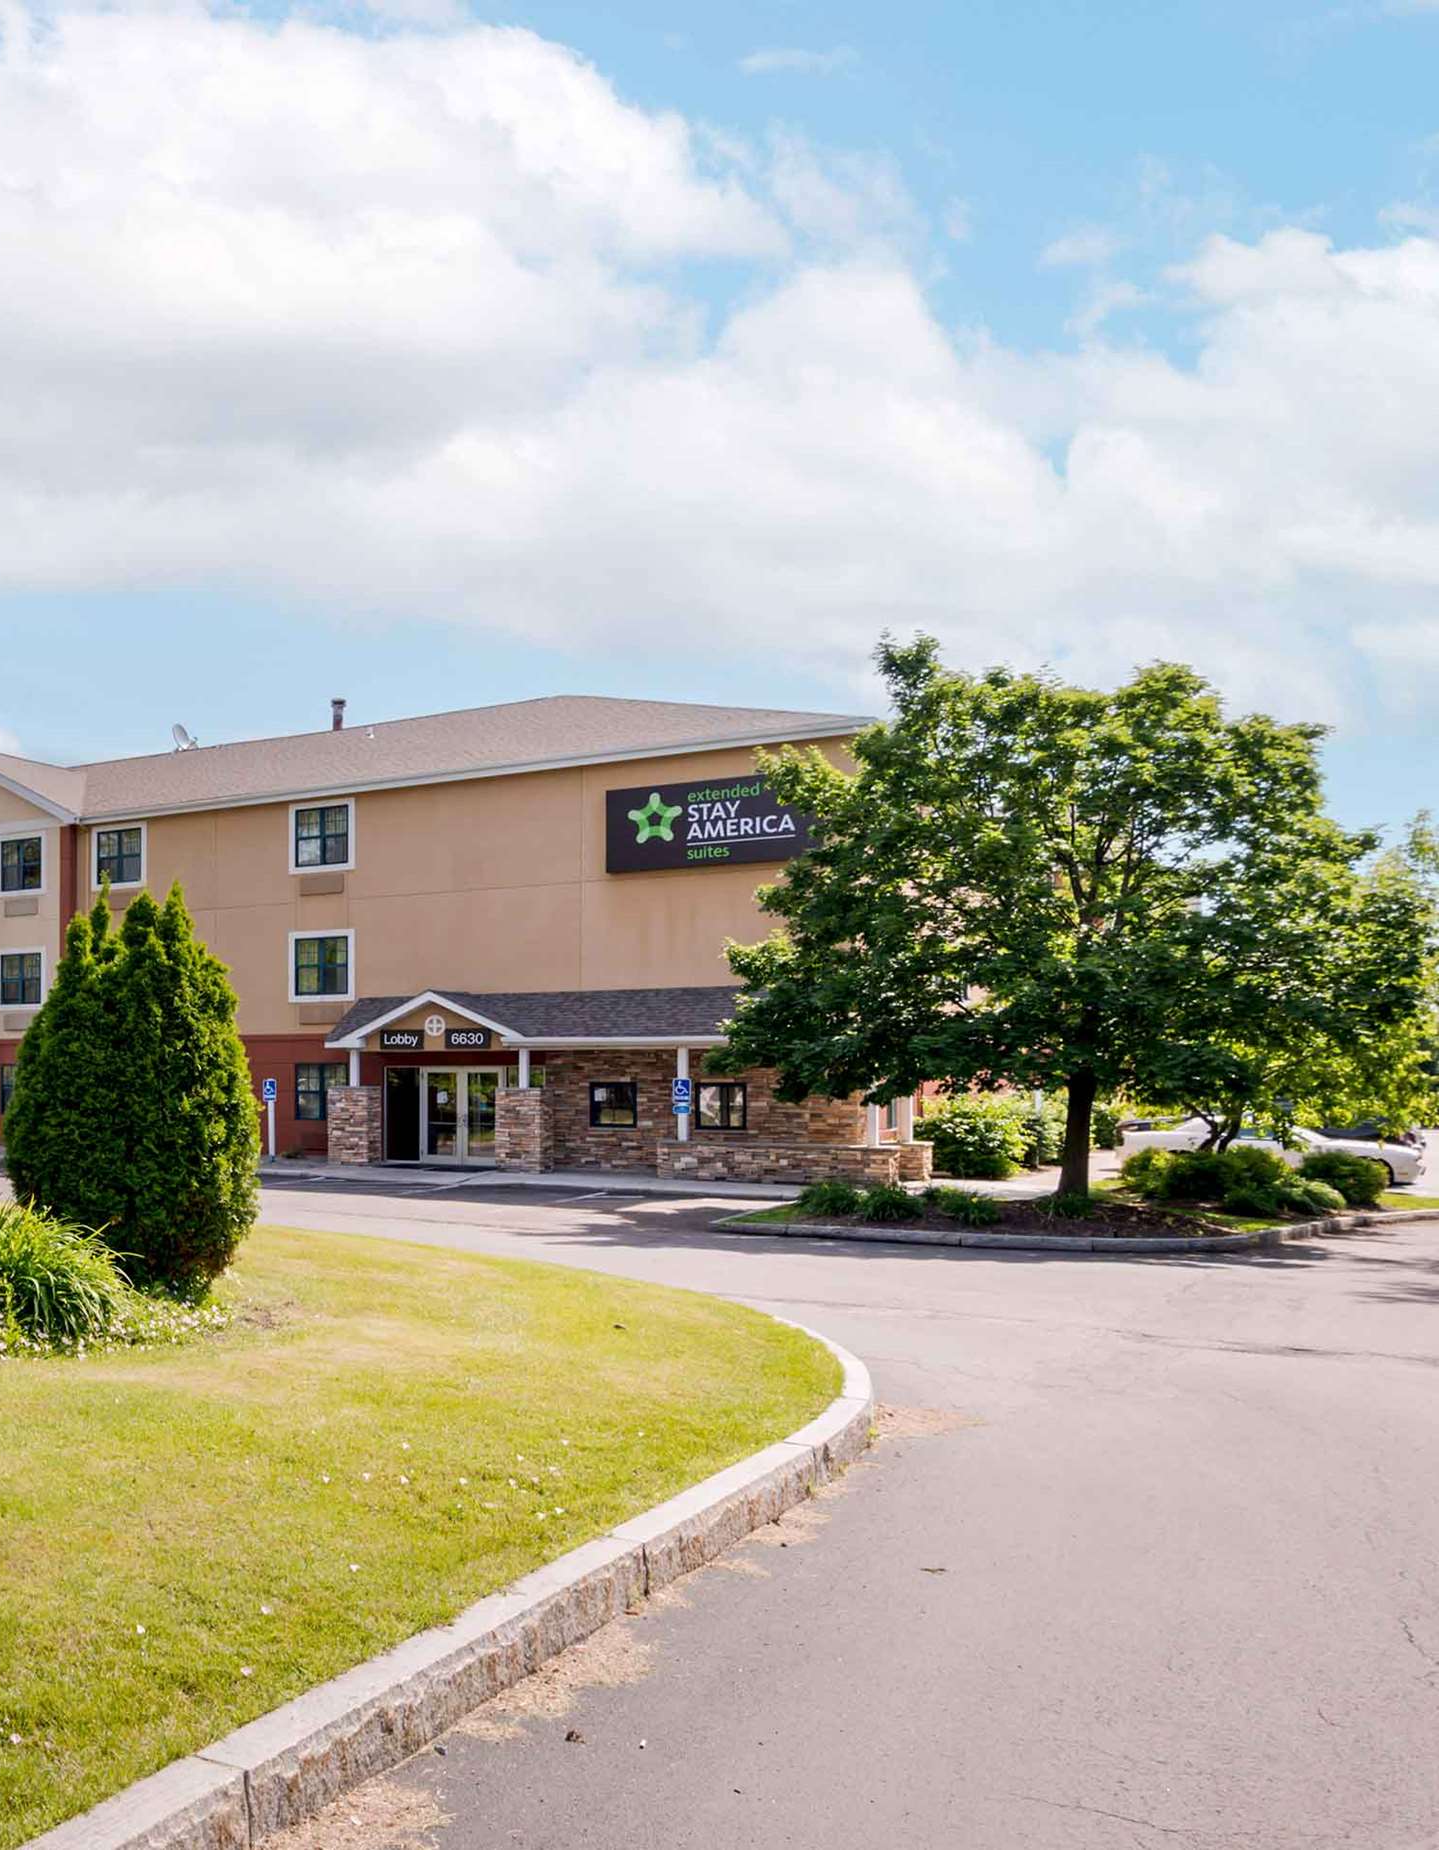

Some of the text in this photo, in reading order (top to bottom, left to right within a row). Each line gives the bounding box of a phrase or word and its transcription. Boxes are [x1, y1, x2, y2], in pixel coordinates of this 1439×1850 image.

[687, 782, 761, 802] extended
[687, 800, 741, 822] STAY
[686, 814, 796, 840] AMERICA
[687, 845, 730, 860] suites
[384, 1033, 418, 1047] Lobby
[451, 1032, 484, 1045] 6630
